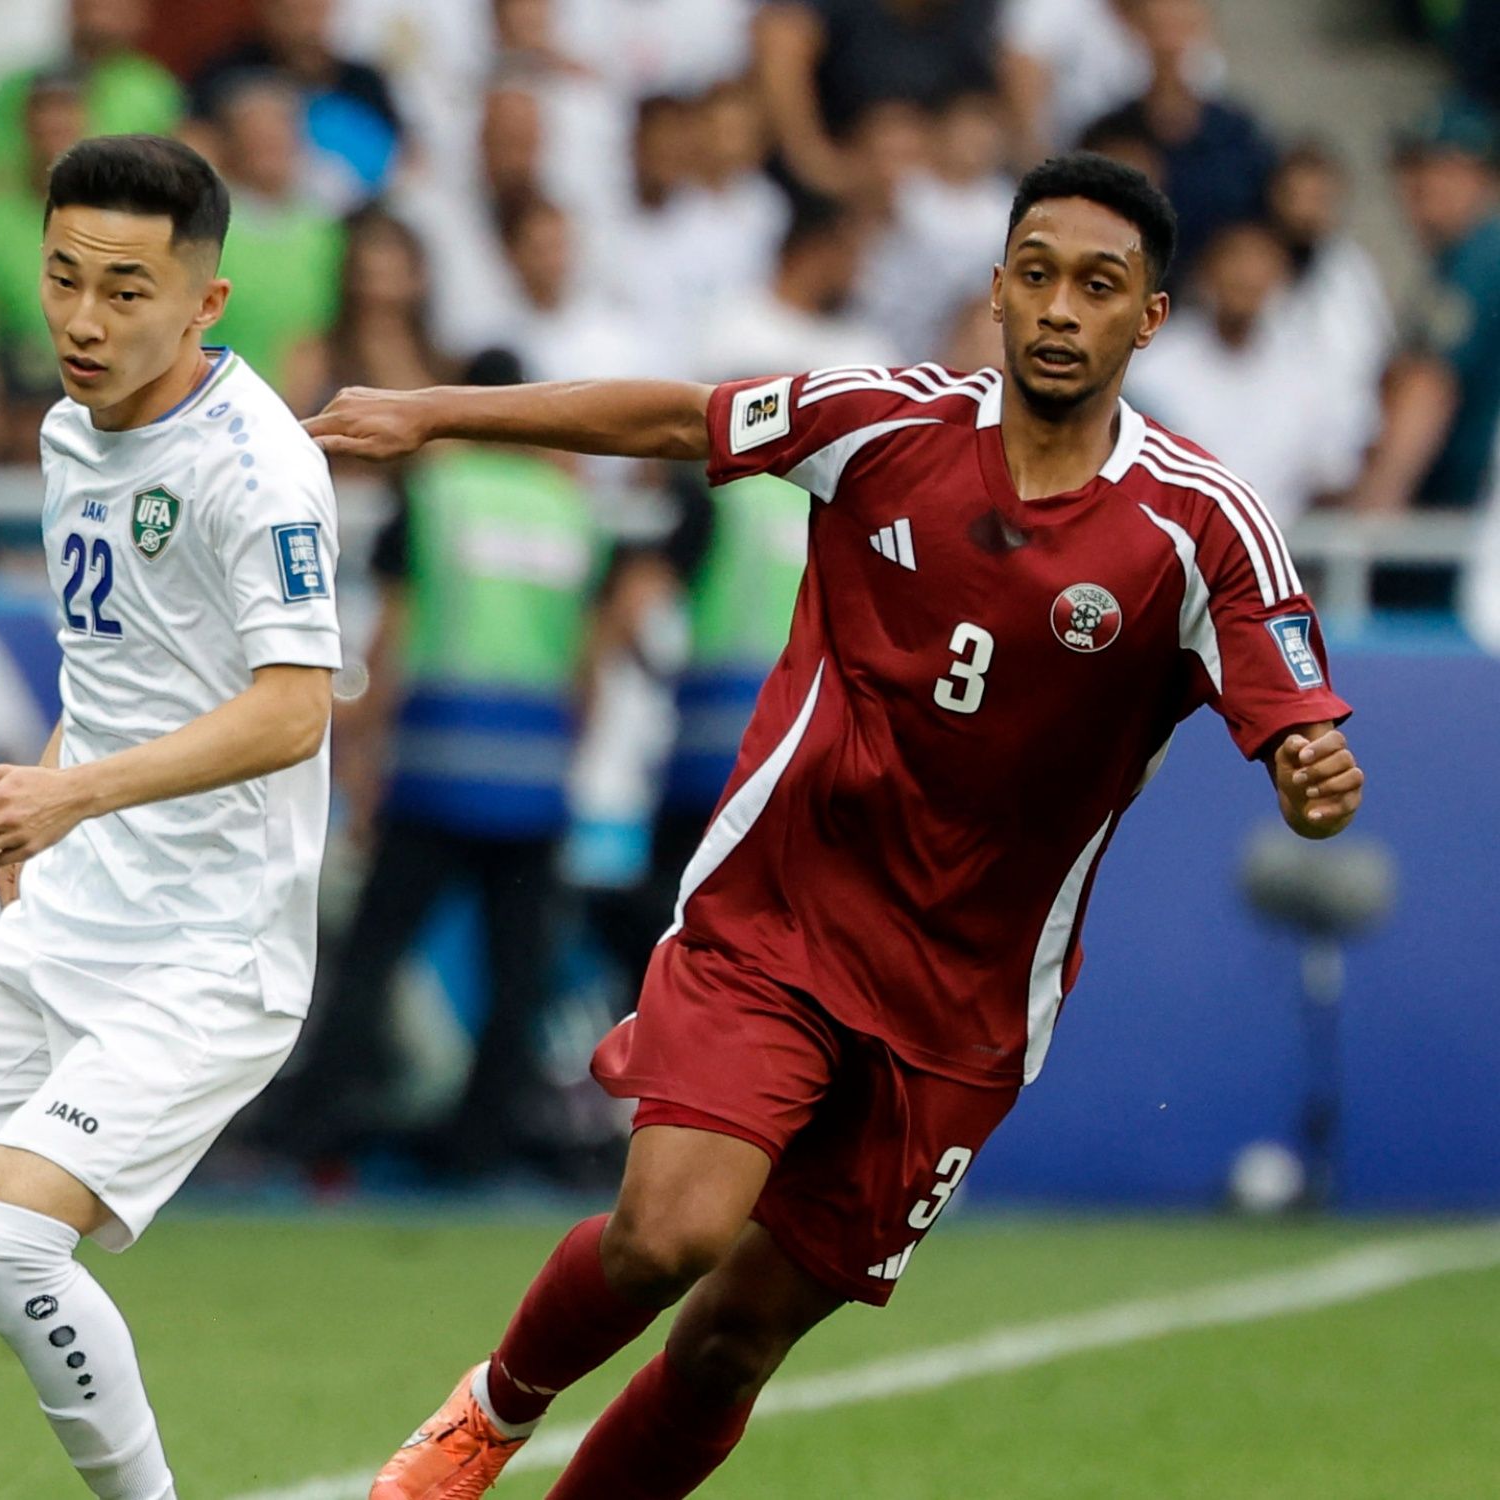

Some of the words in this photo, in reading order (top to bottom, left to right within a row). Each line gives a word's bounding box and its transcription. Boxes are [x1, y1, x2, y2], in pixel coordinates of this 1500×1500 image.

[81, 499, 108, 523] JAK
[137, 499, 171, 527] UFA
[61, 533, 123, 640] 22
[1064, 629, 1094, 650] QFA
[933, 622, 994, 713] 3
[45, 1100, 98, 1135] JAKO
[908, 1146, 973, 1229] 3
